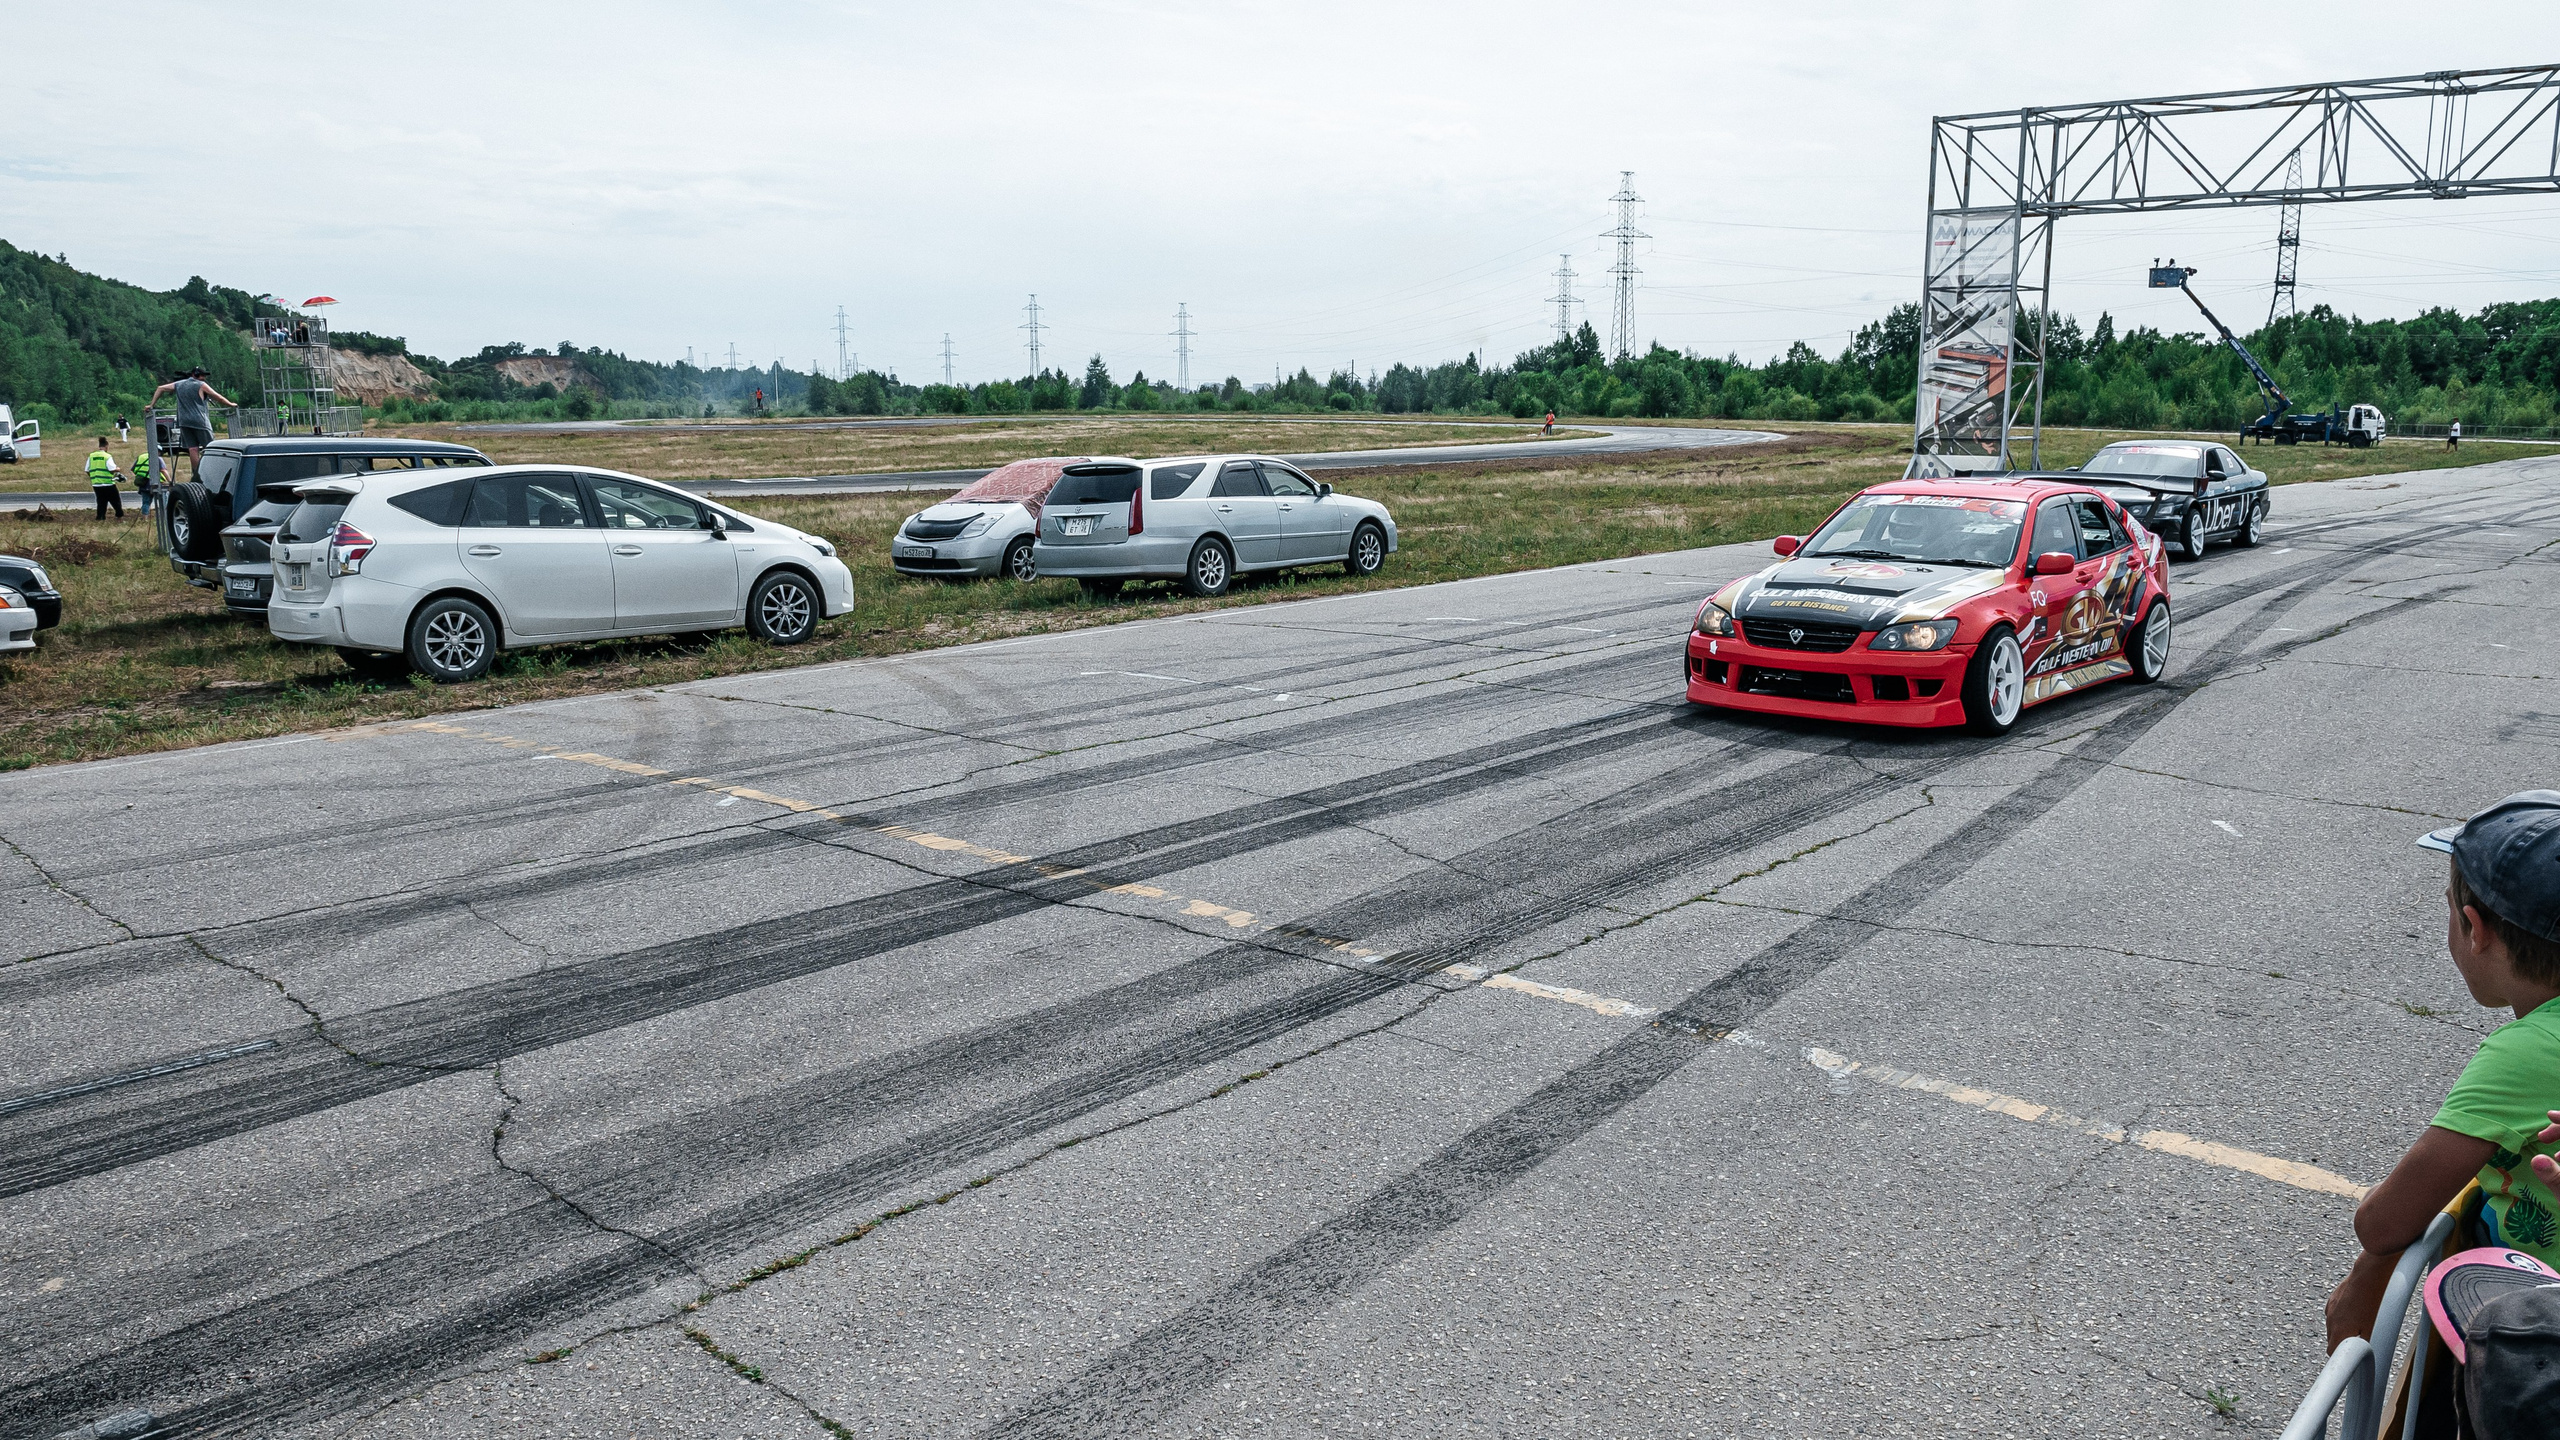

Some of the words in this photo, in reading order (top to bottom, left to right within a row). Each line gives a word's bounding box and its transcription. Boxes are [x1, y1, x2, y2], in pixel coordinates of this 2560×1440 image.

[2204, 498, 2235, 533] Uber
[1749, 589, 1792, 599] GULF
[1792, 588, 1870, 605] WESTERN
[1870, 597, 1897, 609] OIL
[1801, 602, 1850, 612] DISTANCE
[2037, 654, 2061, 674] GULF
[2061, 643, 2100, 666] WESTERN
